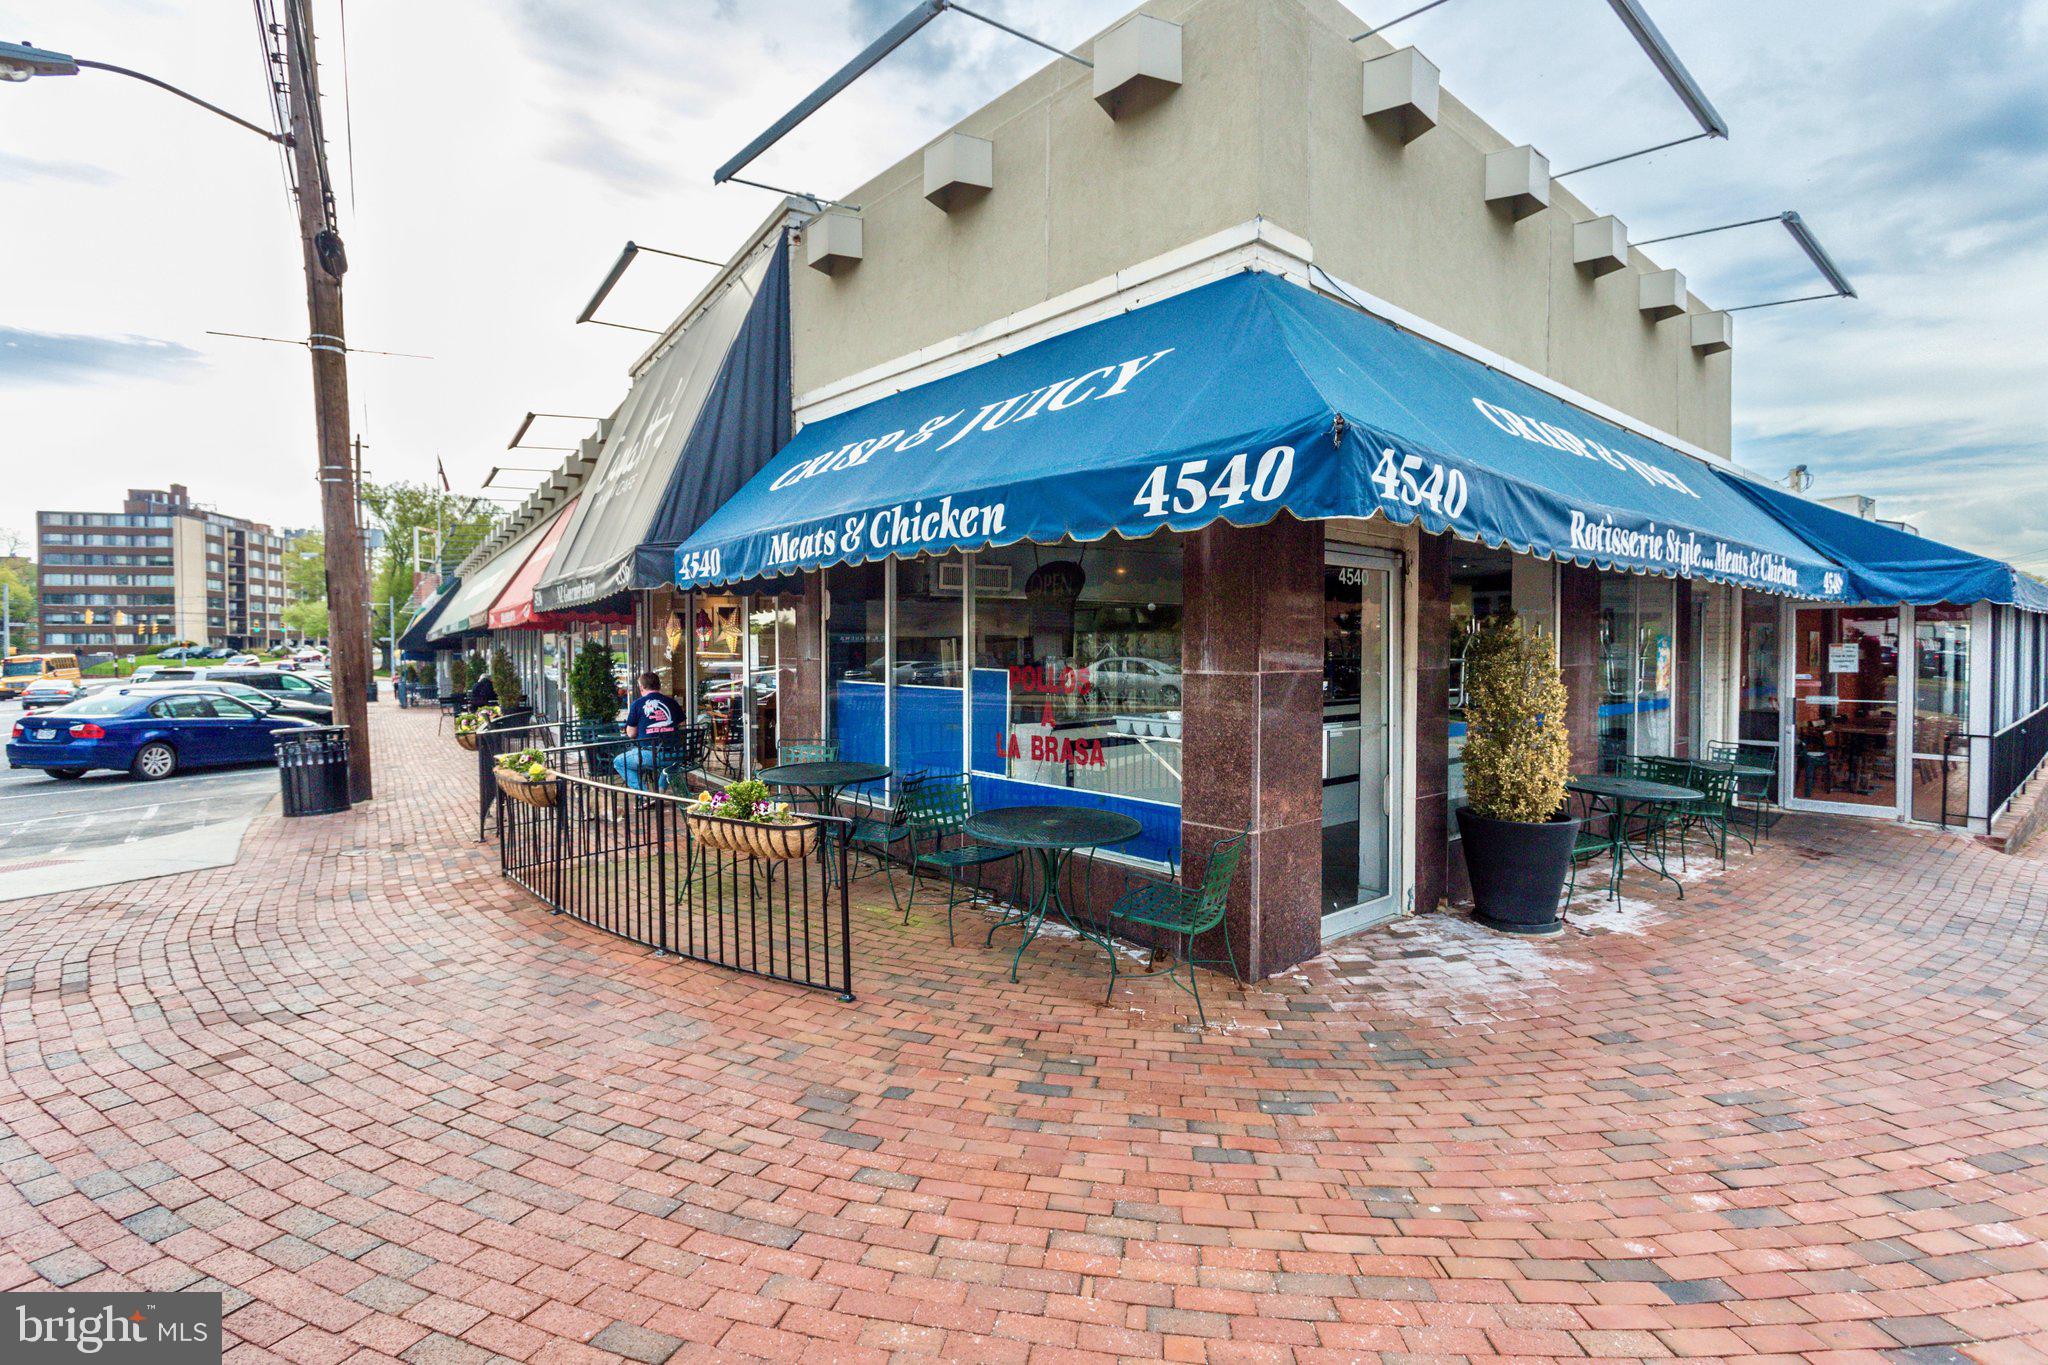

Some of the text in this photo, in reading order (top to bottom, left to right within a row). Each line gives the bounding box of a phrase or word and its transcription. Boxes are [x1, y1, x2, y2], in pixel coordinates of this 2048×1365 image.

[769, 347, 1176, 491] CRISP & JUICY
[1133, 445, 1295, 517] 4540
[1371, 448, 1468, 519] 4540
[766, 495, 1007, 566] Meats & Chicken
[1569, 510, 1663, 560] Rotisserie
[1714, 542, 1748, 577] Meats
[1749, 551, 1761, 579] &
[1761, 553, 1798, 588] Chicken
[678, 547, 721, 581] 4540
[1338, 567, 1369, 586] 4540
[1009, 663, 1092, 695] POLLOS
[1041, 700, 1056, 728] A
[996, 732, 1105, 767] LA BRASA
